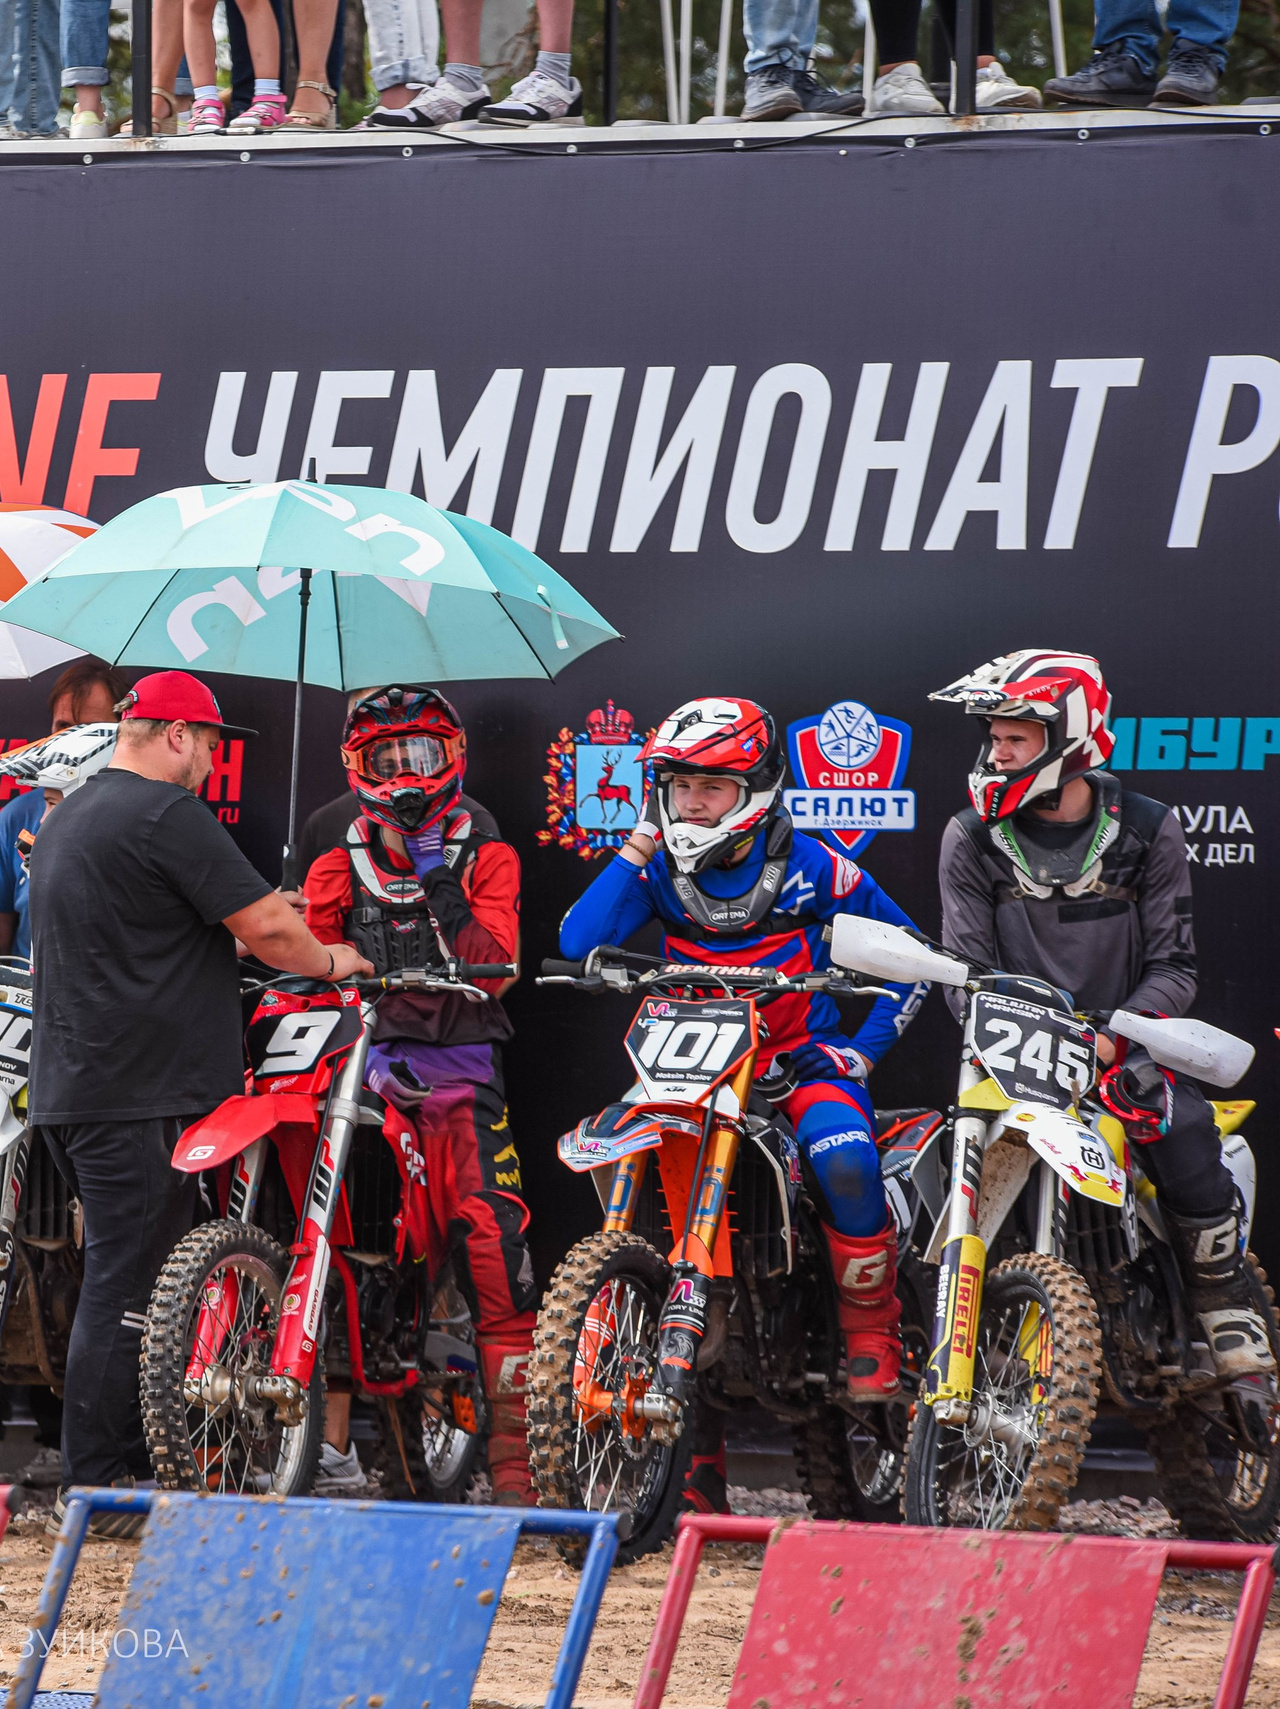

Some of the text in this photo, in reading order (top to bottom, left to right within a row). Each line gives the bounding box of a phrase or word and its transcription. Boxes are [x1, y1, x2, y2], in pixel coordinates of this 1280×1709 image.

[204, 358, 1144, 553] ЧЕМПИОНАТ
[1167, 354, 1280, 549] Р
[818, 771, 879, 787] СШОР
[791, 796, 909, 817] САЛЮТ
[1172, 805, 1255, 834] УЛА
[1204, 843, 1256, 868] ДЕЛ
[663, 963, 766, 977] RENTHAL
[255, 1010, 342, 1076] 9
[637, 1020, 746, 1072] 101
[982, 1017, 1091, 1093] 245
[809, 1129, 871, 1158] ASTARS
[307, 1288, 320, 1332] GASGAS
[952, 1264, 981, 1359] PIRELLI
